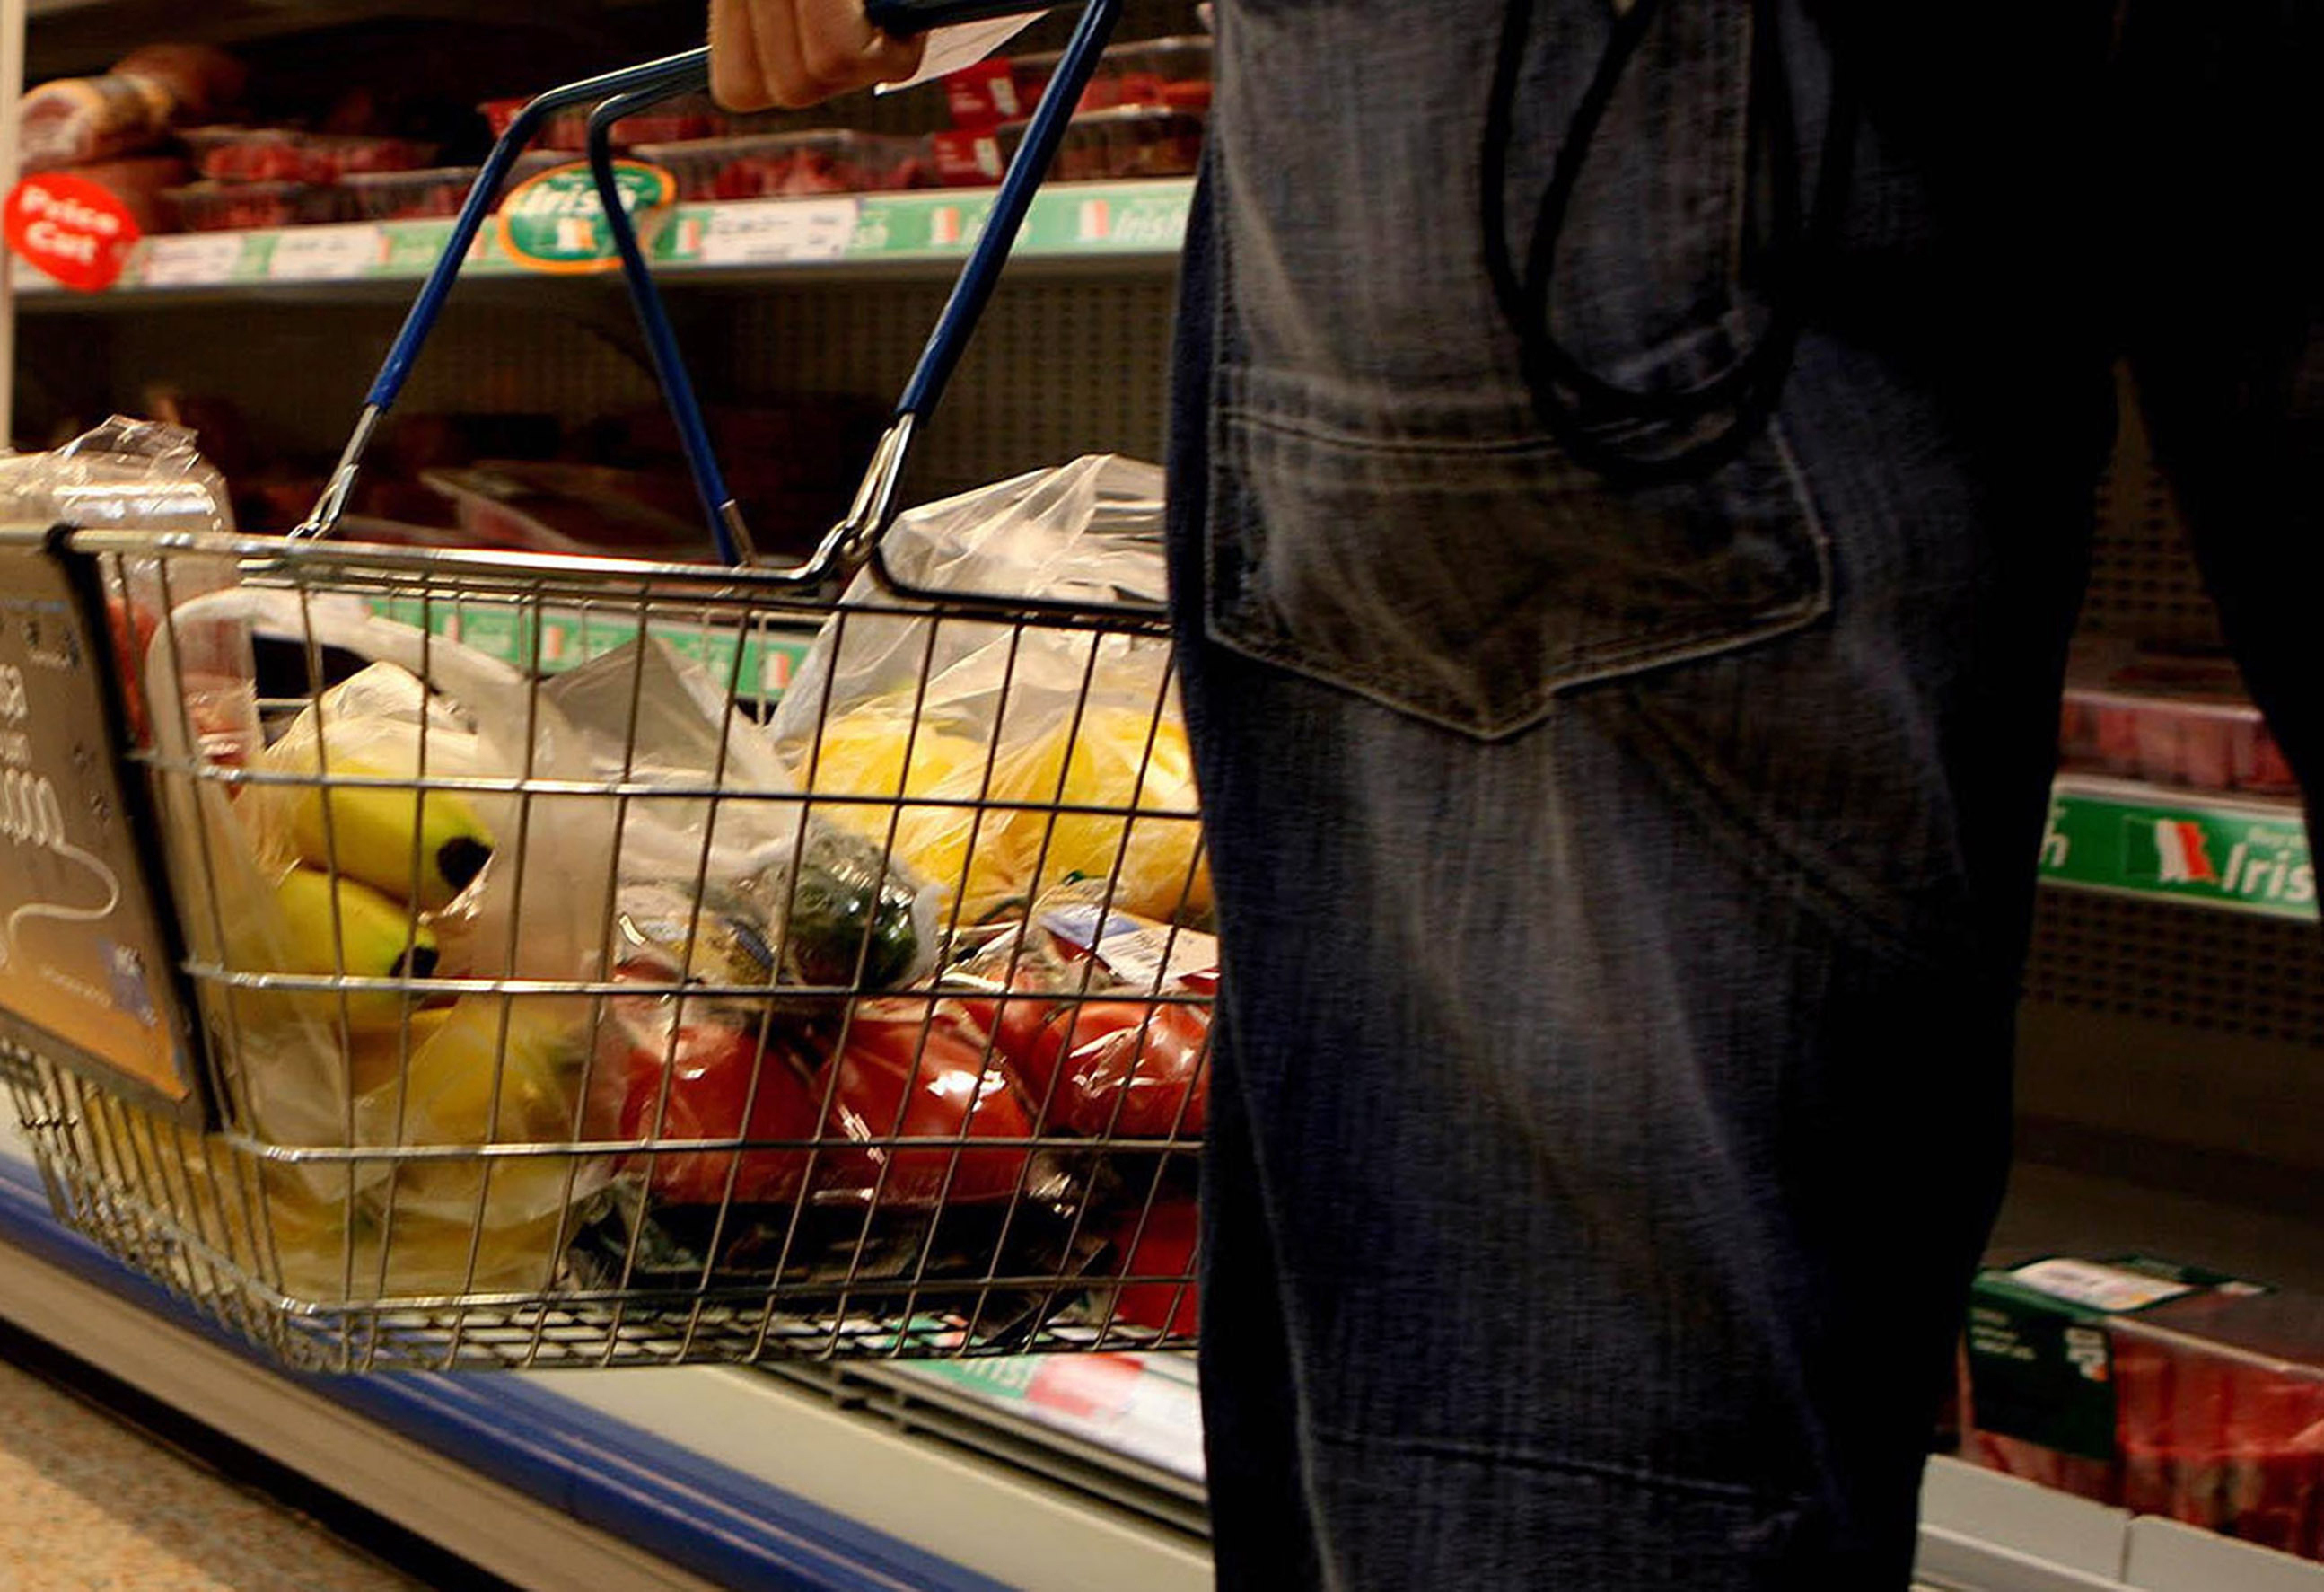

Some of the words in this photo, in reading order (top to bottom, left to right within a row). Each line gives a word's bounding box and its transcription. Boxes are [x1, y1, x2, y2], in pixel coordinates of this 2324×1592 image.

[20, 184, 120, 237] Price
[26, 220, 97, 266] Cut
[2223, 842, 2316, 902] Iris
